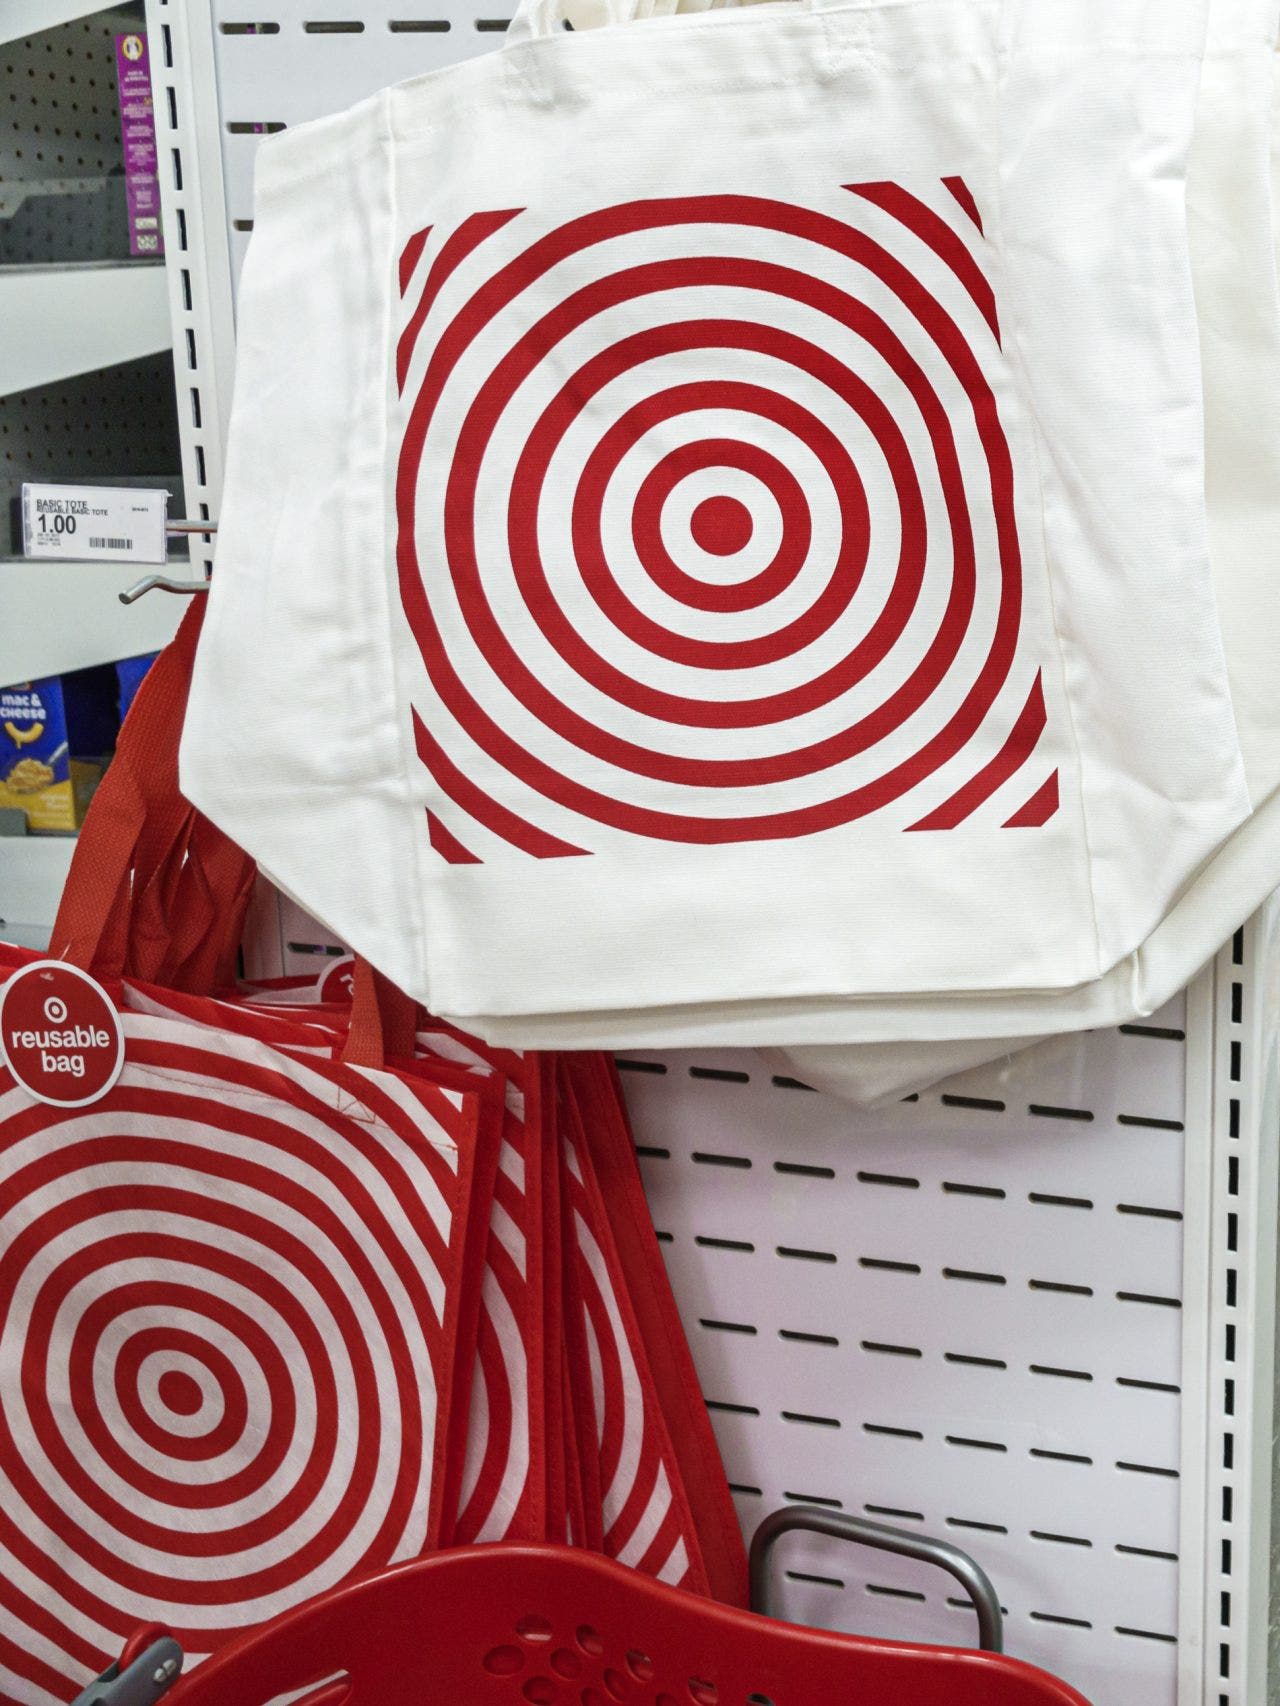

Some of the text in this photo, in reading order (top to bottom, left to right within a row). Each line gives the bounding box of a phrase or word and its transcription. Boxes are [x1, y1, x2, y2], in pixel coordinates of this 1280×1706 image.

[36, 499, 88, 509] BASIC TOTE
[37, 514, 77, 534] 1.00
[1, 693, 42, 707] mac &
[12, 1025, 109, 1048] reusable
[41, 1050, 85, 1077] bag
